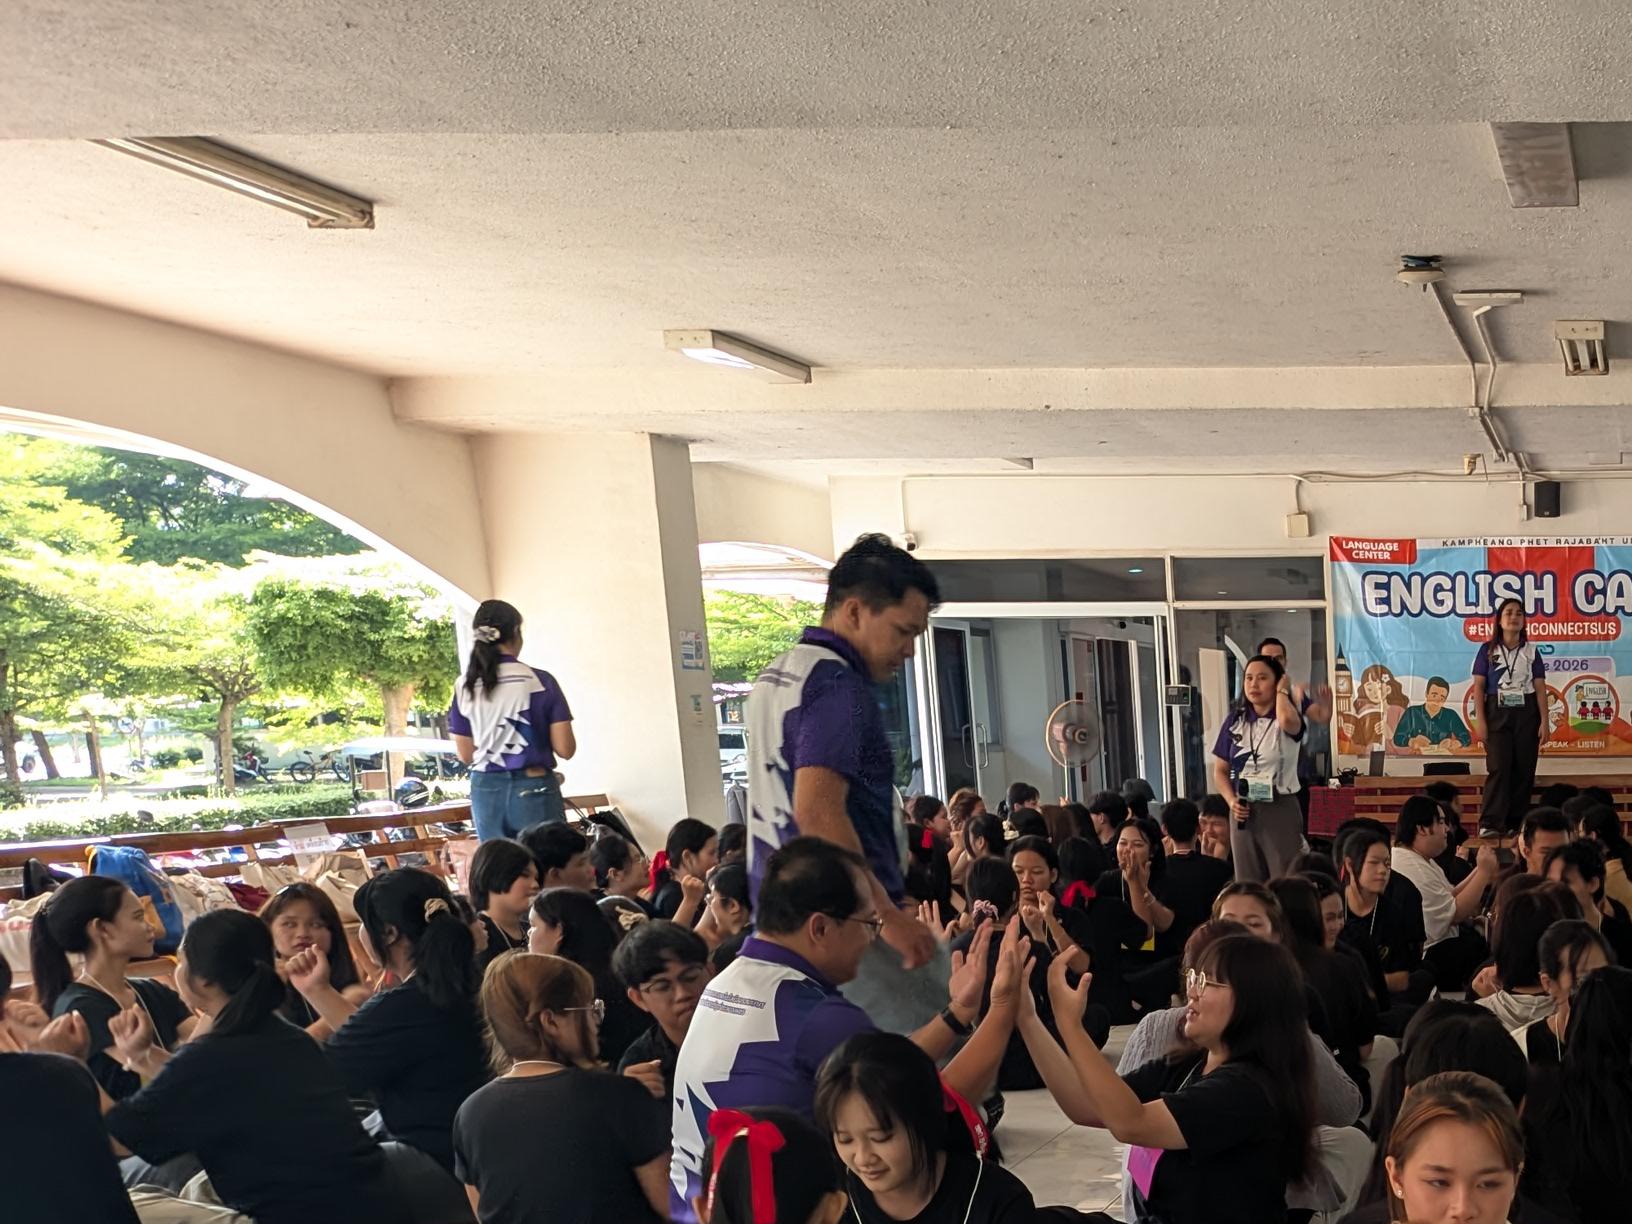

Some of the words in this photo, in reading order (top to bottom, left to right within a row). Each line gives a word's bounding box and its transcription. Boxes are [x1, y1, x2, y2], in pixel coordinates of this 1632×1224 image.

[1342, 540, 1399, 551] LANGUAGE
[1442, 538, 1513, 547] KAMPHEANG
[1520, 538, 1549, 546] PHET
[1352, 550, 1391, 560] CENTER
[1554, 659, 1589, 671] 2026
[1577, 741, 1605, 749] LISTEN
